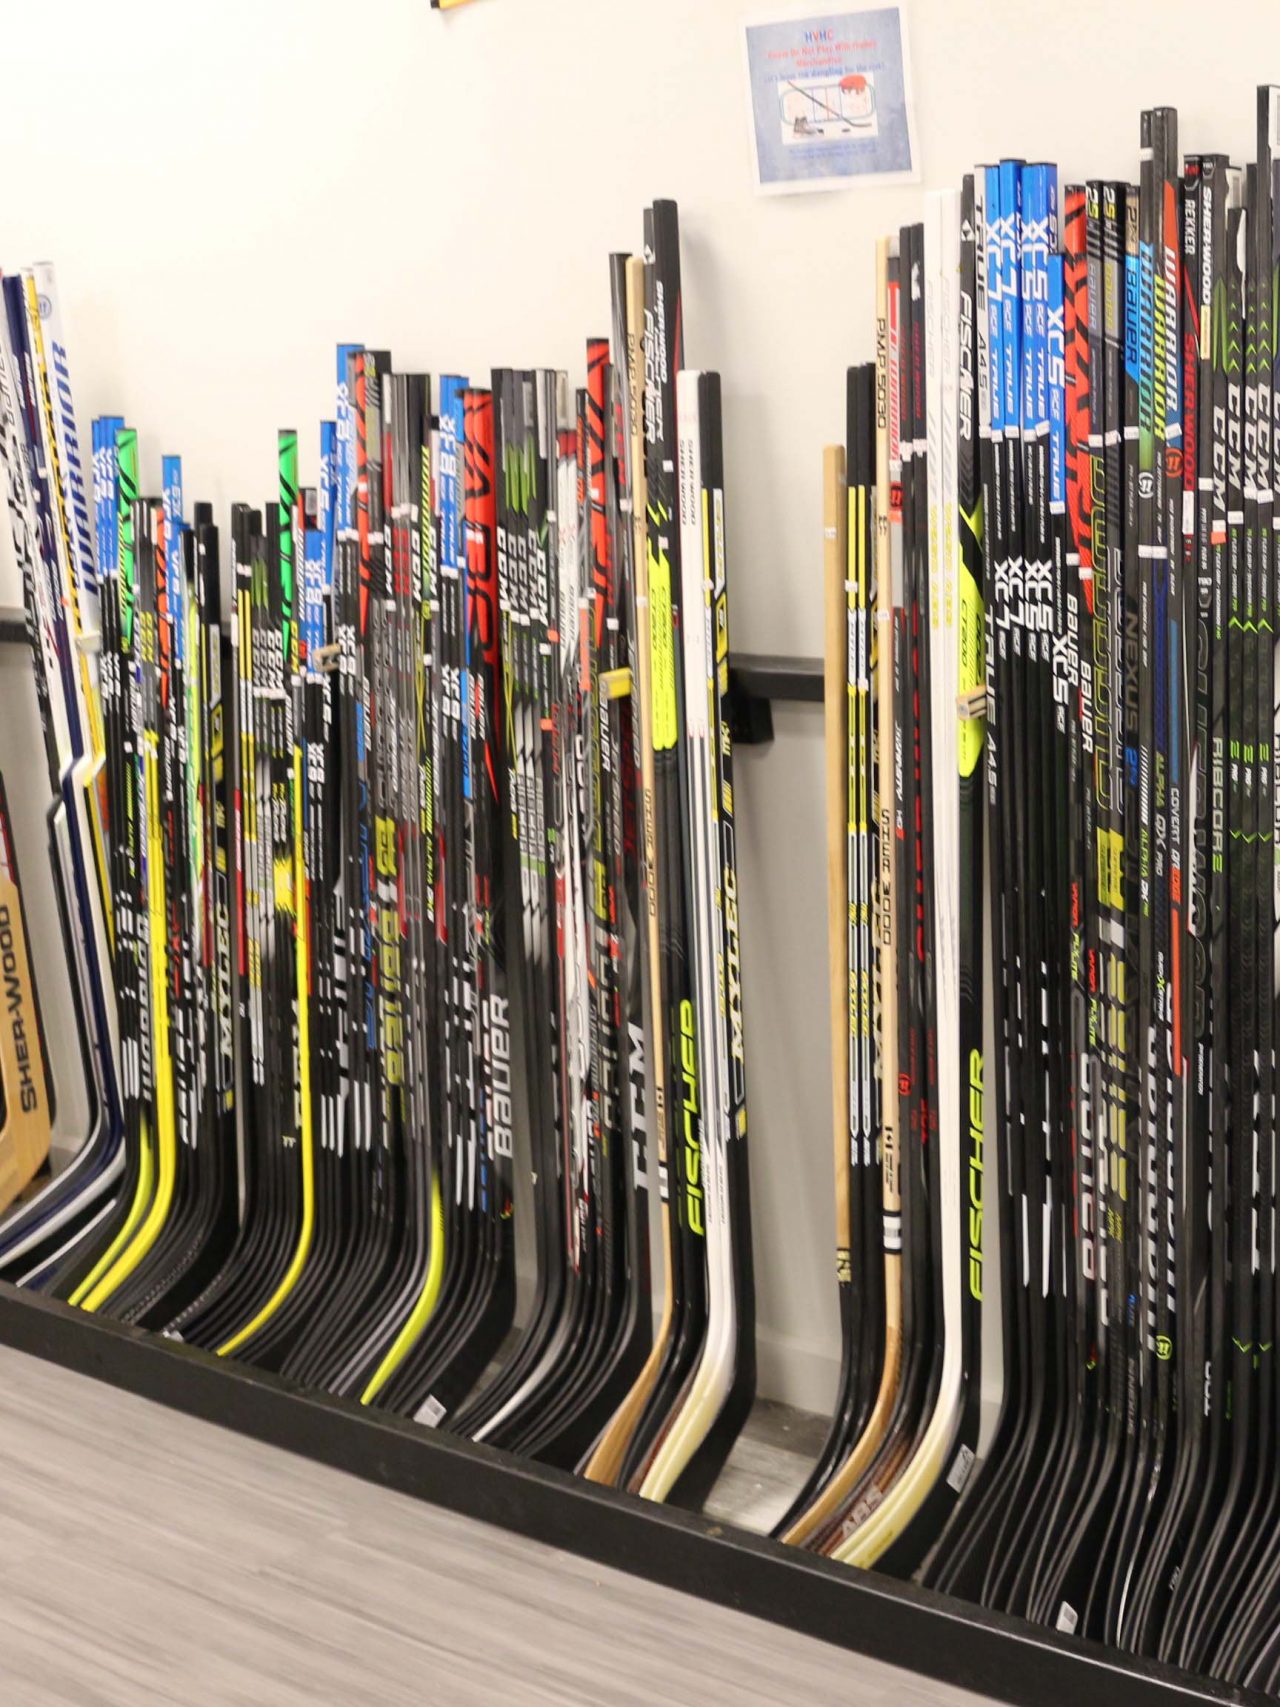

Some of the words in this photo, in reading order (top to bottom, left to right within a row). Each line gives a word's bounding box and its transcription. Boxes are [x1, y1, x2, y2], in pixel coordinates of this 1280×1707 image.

[1185, 200, 1195, 255] REKKER
[643, 309, 655, 444] FISCHER
[960, 291, 972, 440] FISCHER
[1048, 305, 1064, 389] XC5
[1154, 274, 1165, 441] WARRIOR
[1164, 246, 1178, 411] WARRIOR
[52, 343, 97, 594] WARRIOR
[1213, 405, 1225, 513] CCM
[1228, 382, 1240, 491] CCM
[993, 560, 1010, 630] XC7
[1008, 556, 1024, 626] XC7
[1038, 559, 1052, 632] XC5
[985, 604, 995, 726] TRUE
[1053, 635, 1068, 704] XC5
[1125, 609, 1138, 734] NEXUS
[1156, 752, 1164, 807] ALPHA
[1171, 788, 1179, 845] COVERT
[723, 866, 745, 1064] MYLEC
[487, 993, 514, 1158] BAUER
[680, 999, 705, 1236] FISCHER
[967, 1049, 984, 1301] FISCHER
